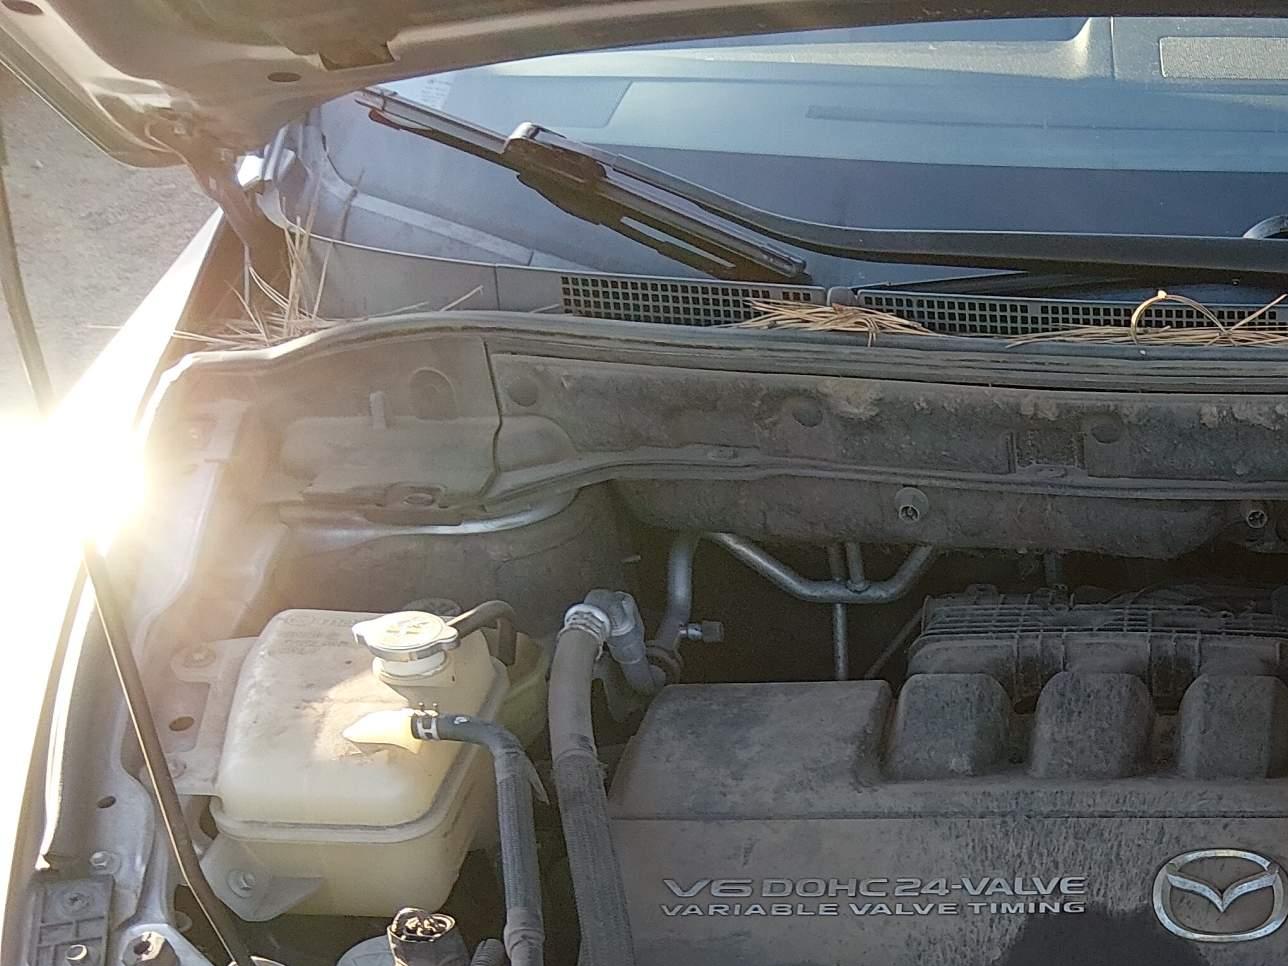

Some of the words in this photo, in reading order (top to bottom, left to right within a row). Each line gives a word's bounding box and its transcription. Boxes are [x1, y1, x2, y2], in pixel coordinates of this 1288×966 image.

[663, 878, 753, 898] V6
[761, 877, 889, 898] DOHC
[894, 876, 1086, 896] 24-VALVE
[661, 903, 840, 916] VARIABLE
[849, 902, 959, 915] VALVE
[967, 901, 1086, 914] TIMING
